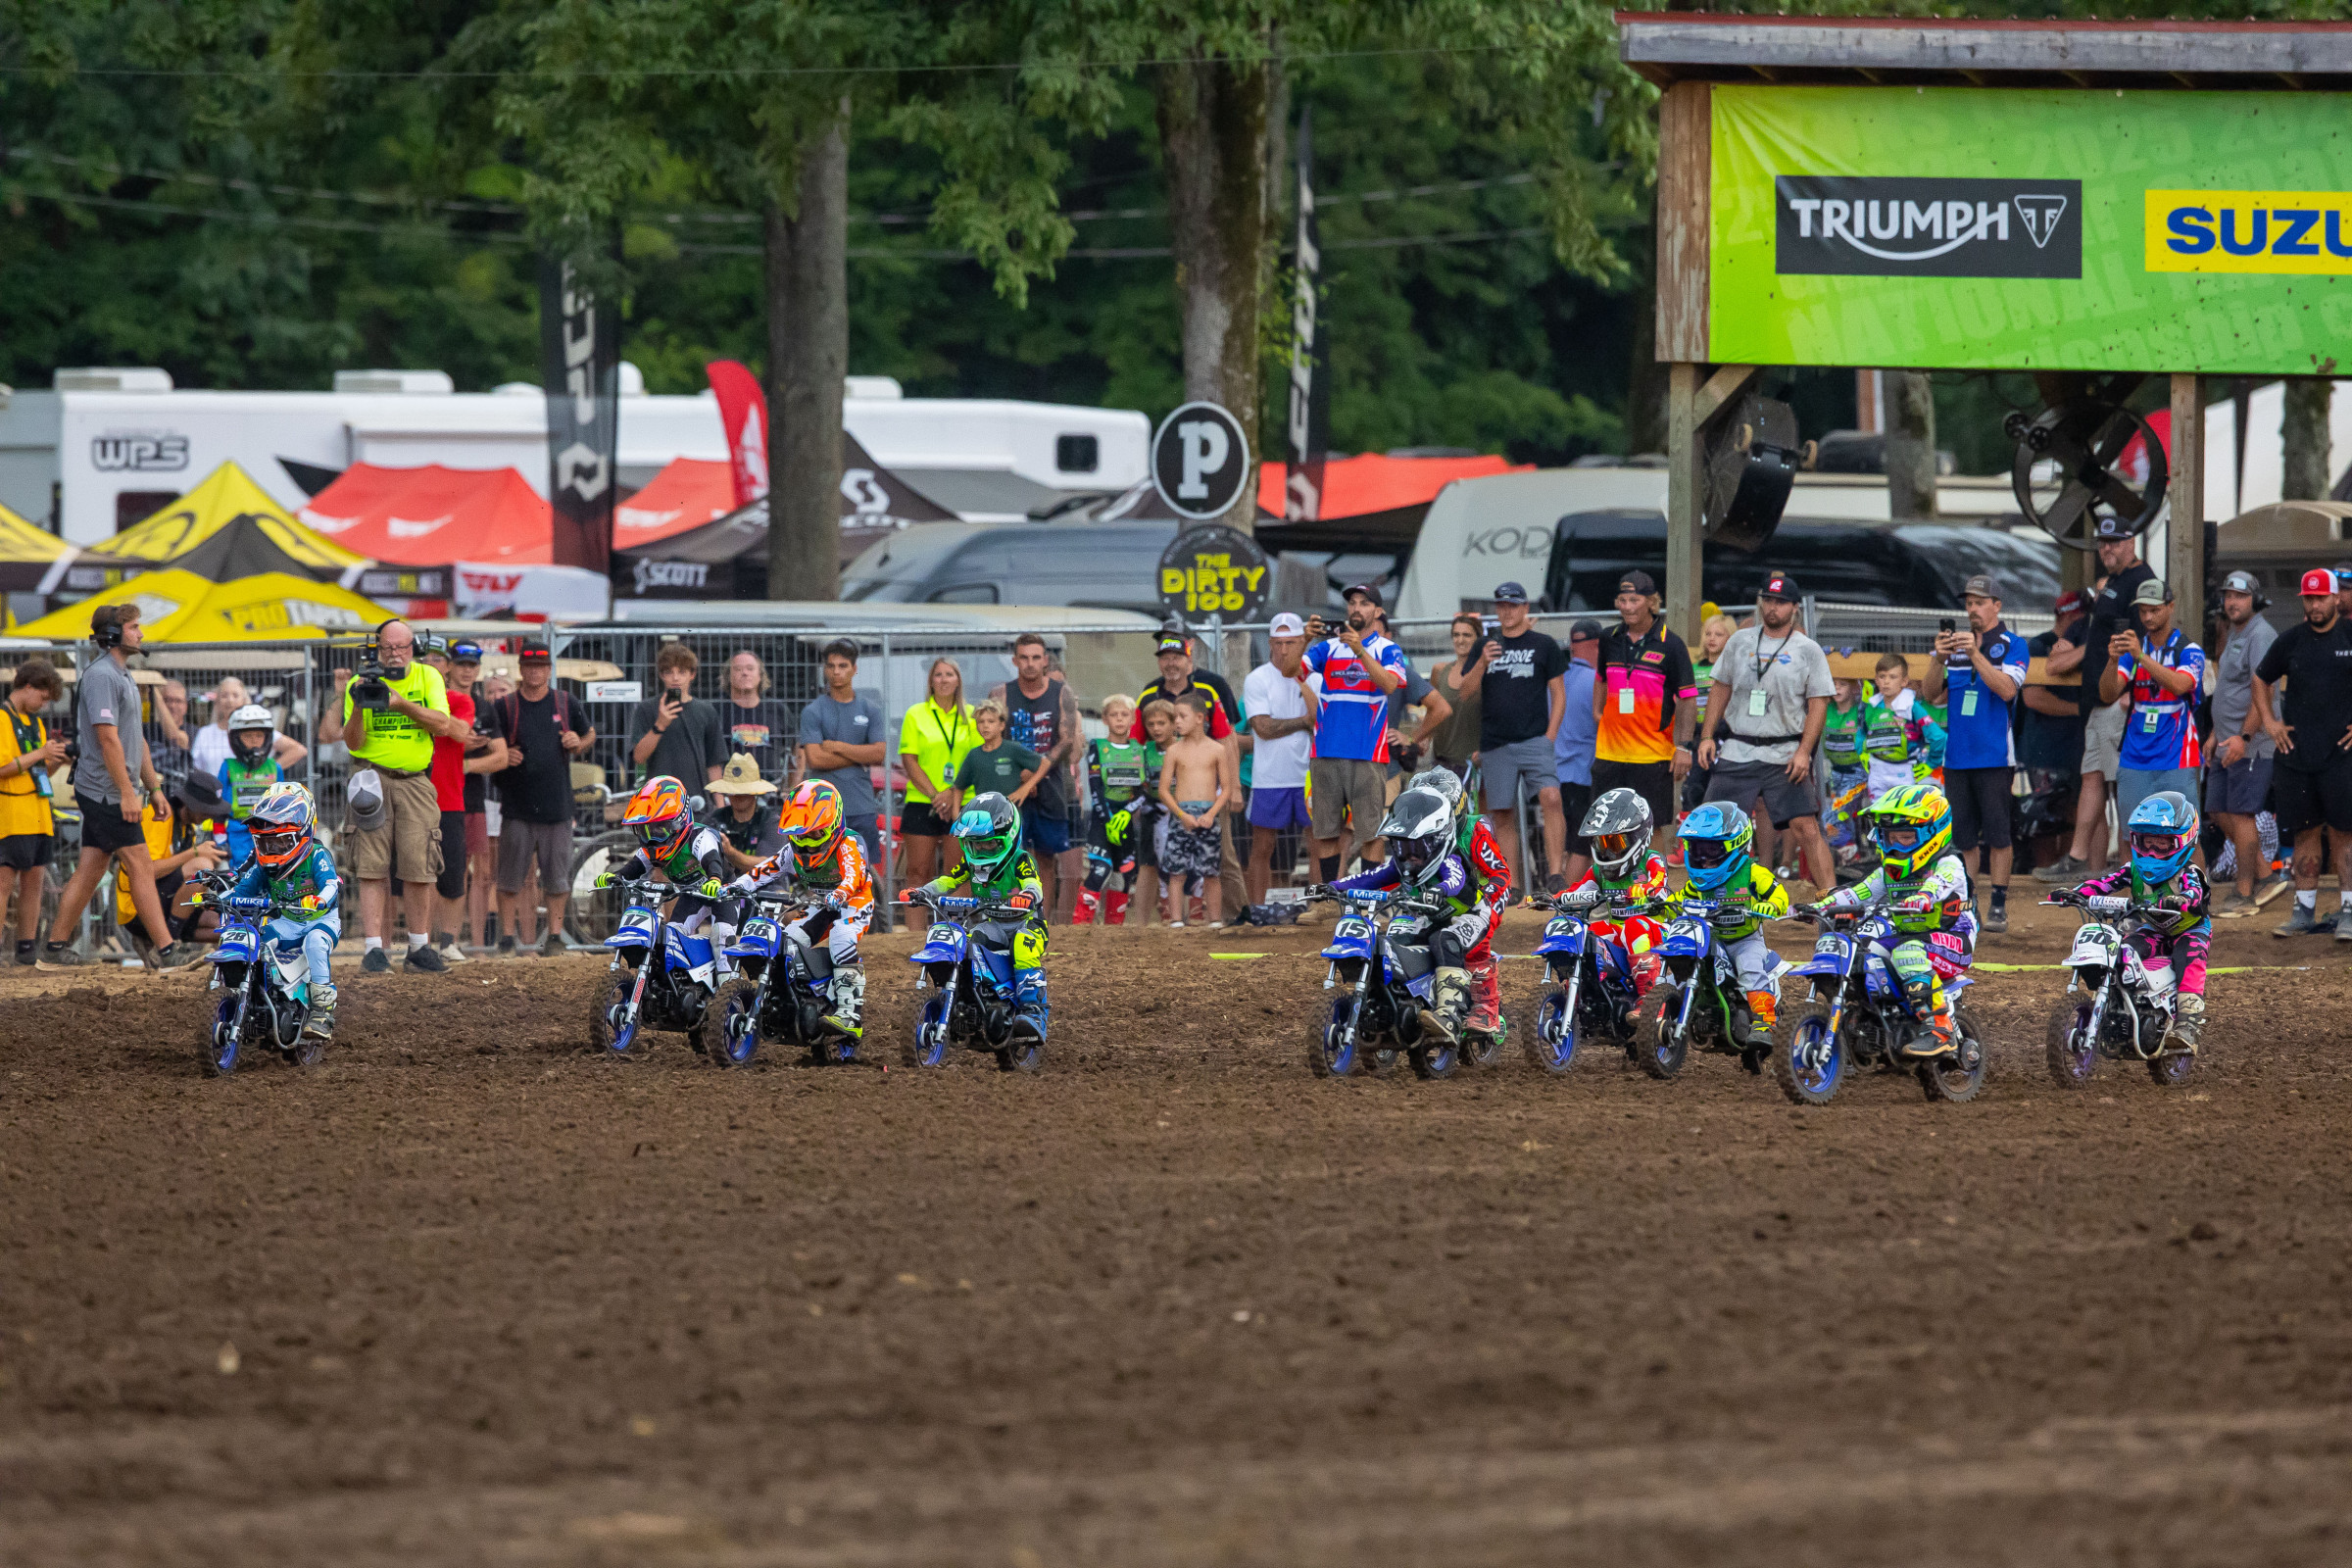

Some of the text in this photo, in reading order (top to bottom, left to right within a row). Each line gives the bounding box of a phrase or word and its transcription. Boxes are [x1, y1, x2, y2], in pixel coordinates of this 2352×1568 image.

[1789, 198, 2009, 261] TRIUMPH
[91, 435, 189, 471] WPS
[1178, 420, 1230, 499] P
[1196, 553, 1231, 568] THE
[646, 562, 709, 587] SCOTT
[1161, 565, 1265, 593] DIRTY
[1185, 590, 1245, 612] 100
[1917, 841, 1938, 861] KNOX
[235, 897, 264, 906] Mika
[1352, 890, 1384, 901] Mika
[1562, 892, 1595, 903] Mika
[623, 913, 649, 927] 17
[224, 931, 247, 942] 28
[742, 922, 772, 938] 36
[1338, 922, 1368, 938] 15
[1669, 923, 1698, 936] 27
